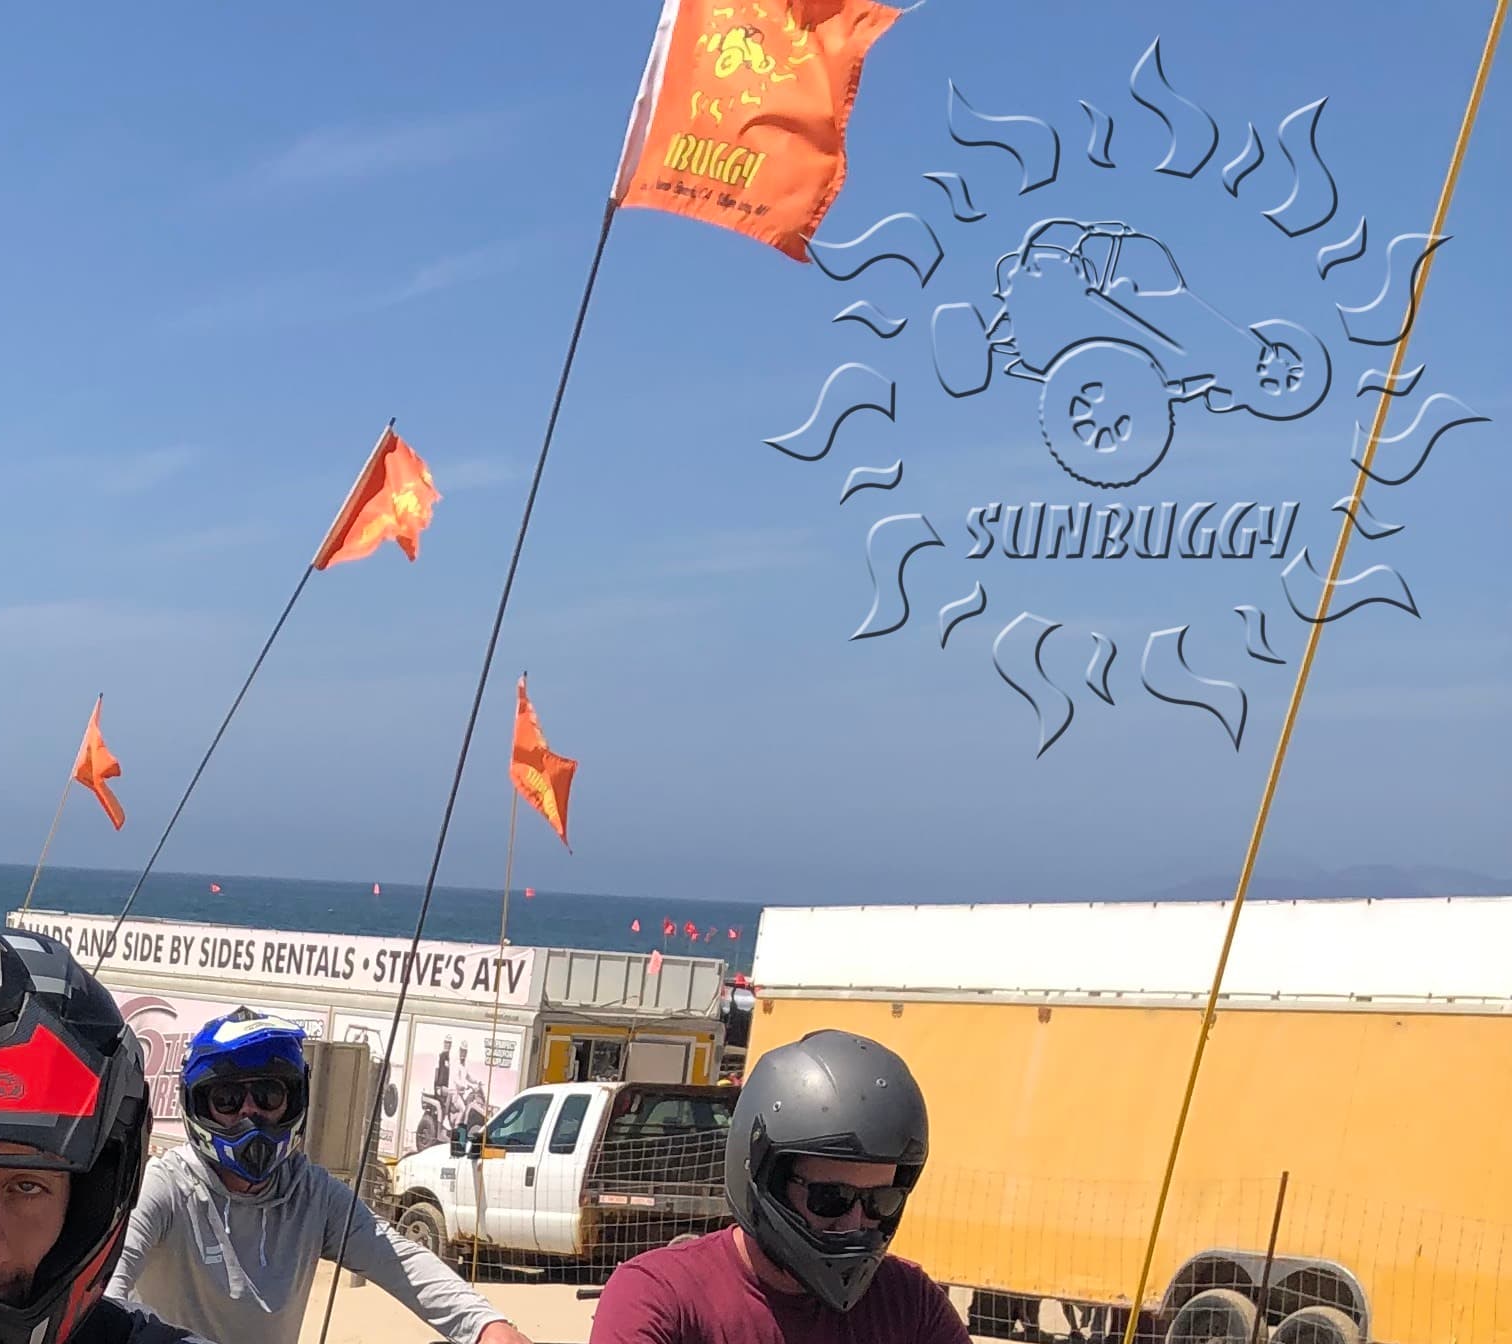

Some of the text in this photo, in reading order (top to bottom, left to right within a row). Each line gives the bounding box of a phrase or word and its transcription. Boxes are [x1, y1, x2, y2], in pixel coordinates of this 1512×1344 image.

[76, 927, 118, 959] AND
[122, 931, 166, 964] SIDE
[169, 934, 195, 966] BY
[198, 936, 256, 972] SIDES
[261, 941, 356, 980] RENTALS
[373, 948, 466, 990] STEVE'S
[471, 957, 527, 994] ATV
